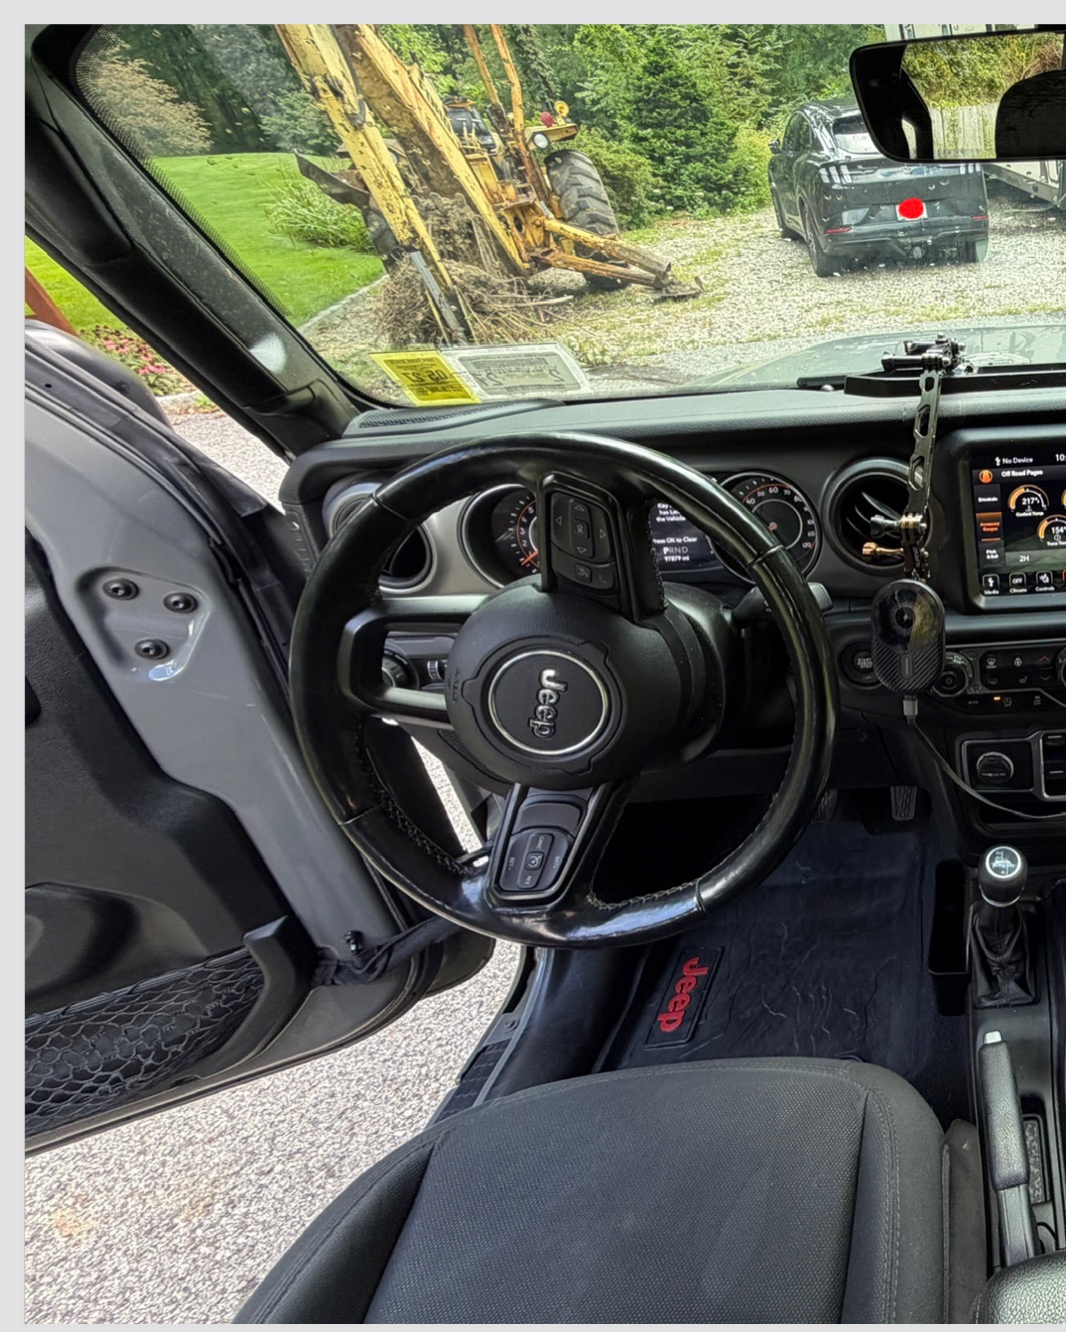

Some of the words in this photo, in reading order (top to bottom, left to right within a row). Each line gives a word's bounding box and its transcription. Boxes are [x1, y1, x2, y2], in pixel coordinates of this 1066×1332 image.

[1026, 469, 1043, 477] Pages
[768, 486, 779, 494] 60
[745, 497, 756, 505] 40
[663, 546, 689, 555] PRND
[682, 554, 690, 562] mi
[1019, 555, 1030, 563] 2H
[529, 668, 569, 740] Jeep
[657, 957, 710, 1033] Jeep
